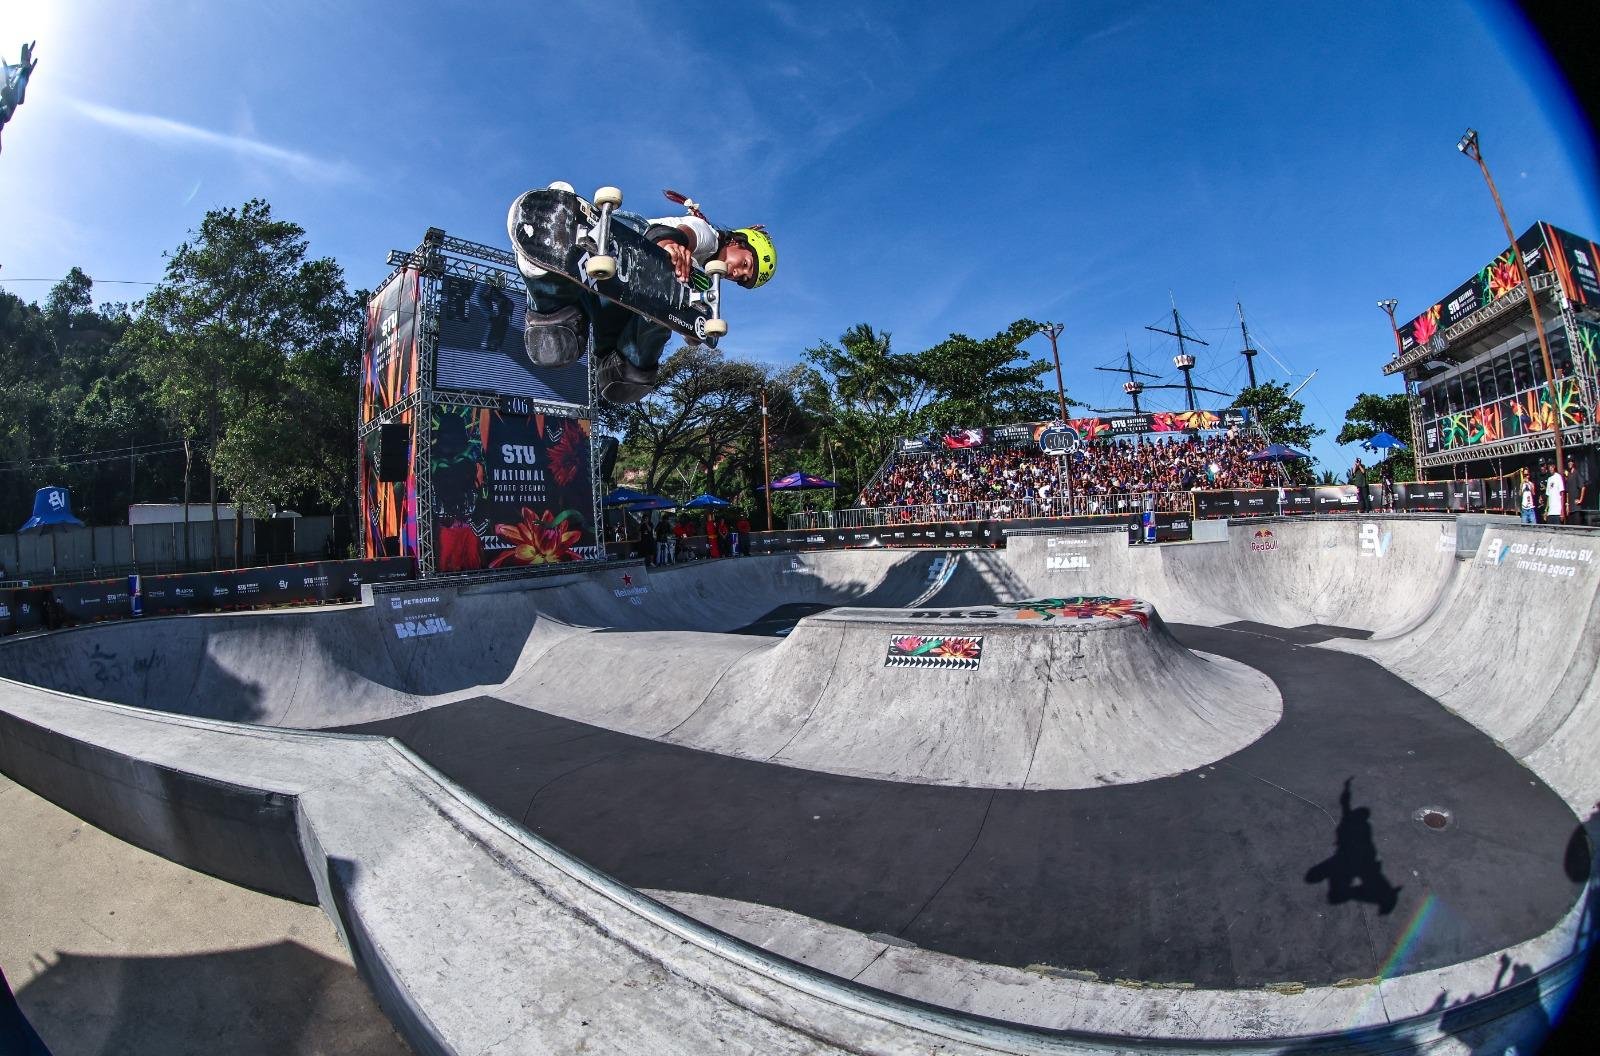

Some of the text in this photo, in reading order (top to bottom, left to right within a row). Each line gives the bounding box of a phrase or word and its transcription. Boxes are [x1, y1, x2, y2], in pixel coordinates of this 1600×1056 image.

[1448, 299, 1460, 314] STU
[1111, 419, 1127, 428] STU
[994, 429, 1008, 437] STU
[501, 443, 536, 465] STU
[493, 468, 545, 481] NATIONAL
[494, 484, 546, 492] PORTO SEGURO
[1251, 540, 1278, 551] Red Bull
[1510, 543, 1594, 564] CDB é no banco BV,
[1046, 556, 1091, 569] BRASIL
[1517, 557, 1576, 578] invista agora
[614, 586, 648, 598] Heineken
[404, 596, 440, 606] PETROBRAS
[394, 617, 453, 639] BRASIL
